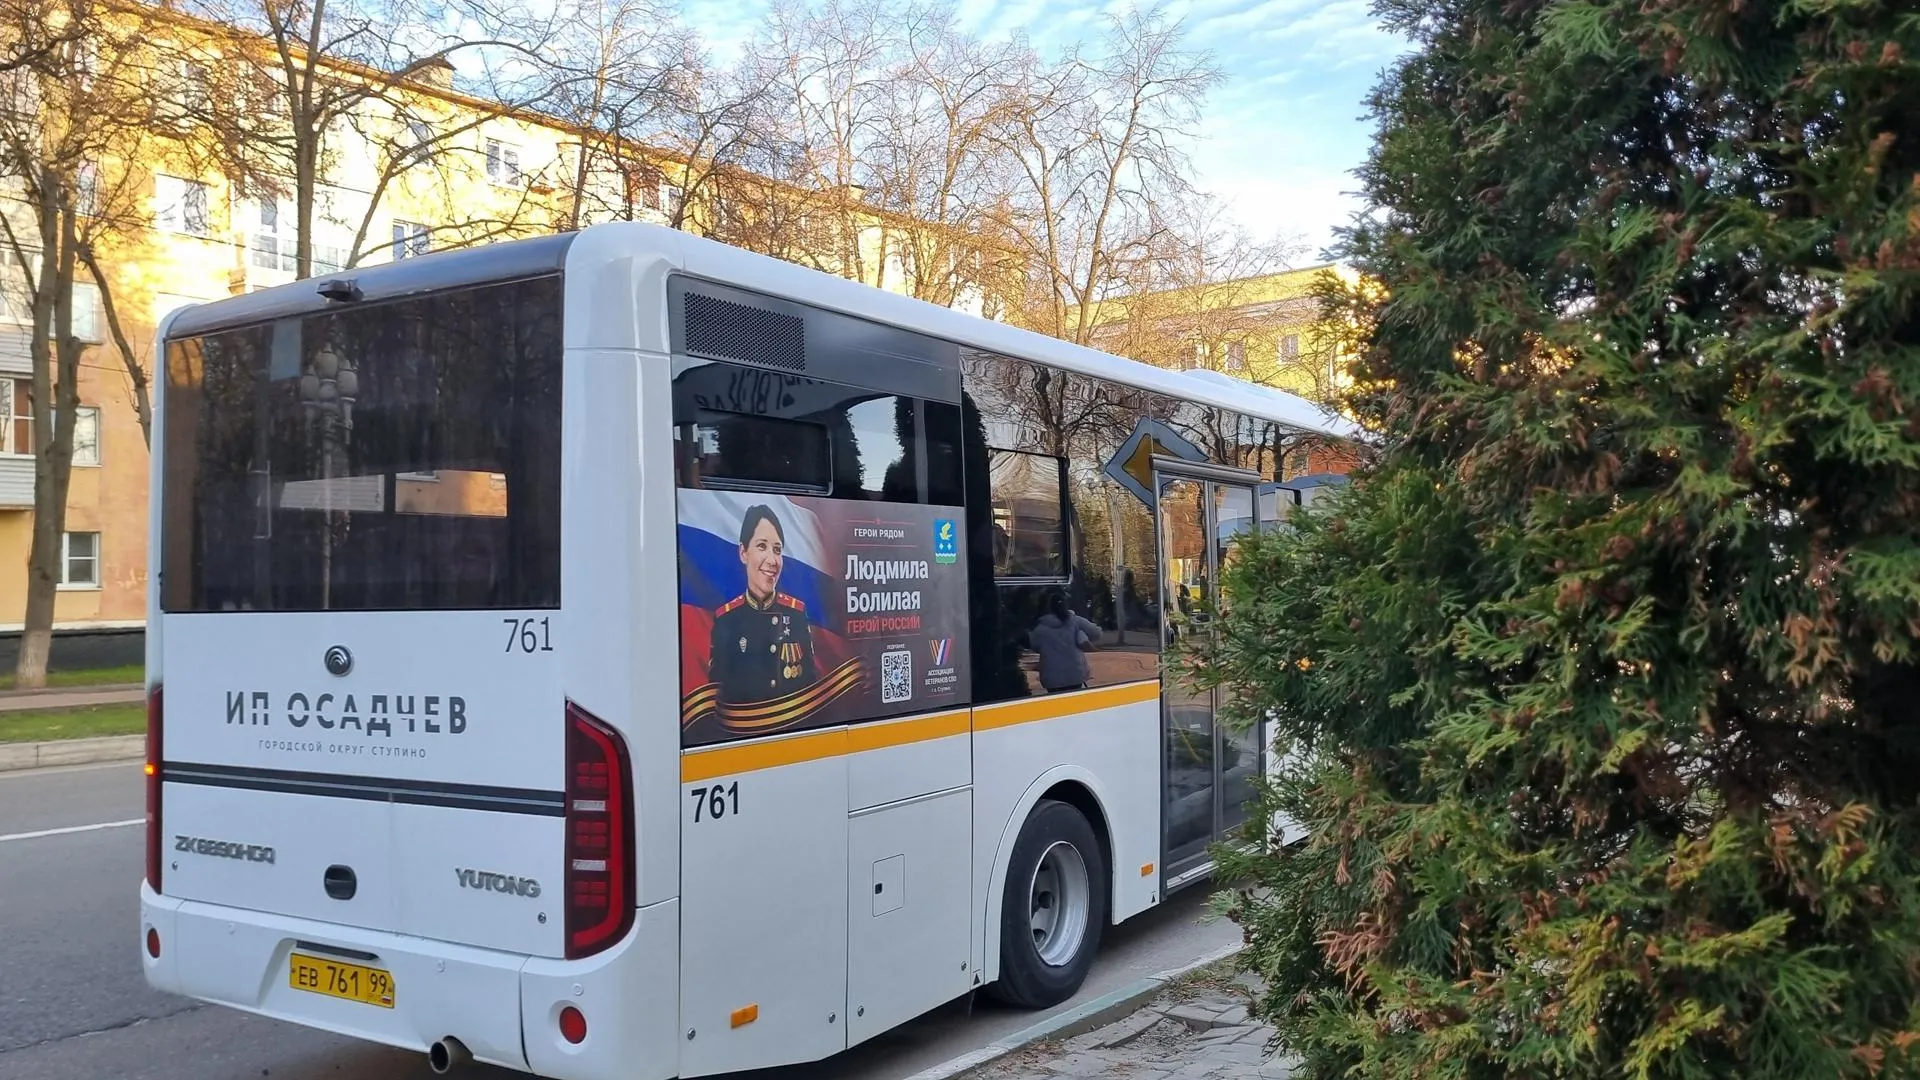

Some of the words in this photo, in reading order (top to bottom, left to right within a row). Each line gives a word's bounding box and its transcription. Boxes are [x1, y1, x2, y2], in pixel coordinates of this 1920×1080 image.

[854, 528, 878, 538] ГЕРОИ
[879, 529, 904, 540] РЯДОМ
[845, 554, 929, 585] Людмила
[846, 586, 921, 613] Болилая
[503, 616, 553, 653] 761
[847, 616, 879, 634] ГЕРОЙ
[881, 615, 921, 631] РОССИИ
[226, 691, 269, 726] ИП
[287, 692, 467, 738] ОСАДЧЕВ
[258, 740, 322, 753] ГОРОДСКОЙ
[329, 744, 365, 755] ОКРУГ
[371, 746, 427, 759] СТУПИНО
[690, 781, 739, 823] 761
[455, 867, 542, 898] YUTONG
[326, 965, 360, 997] 761
[369, 972, 388, 994] 99
